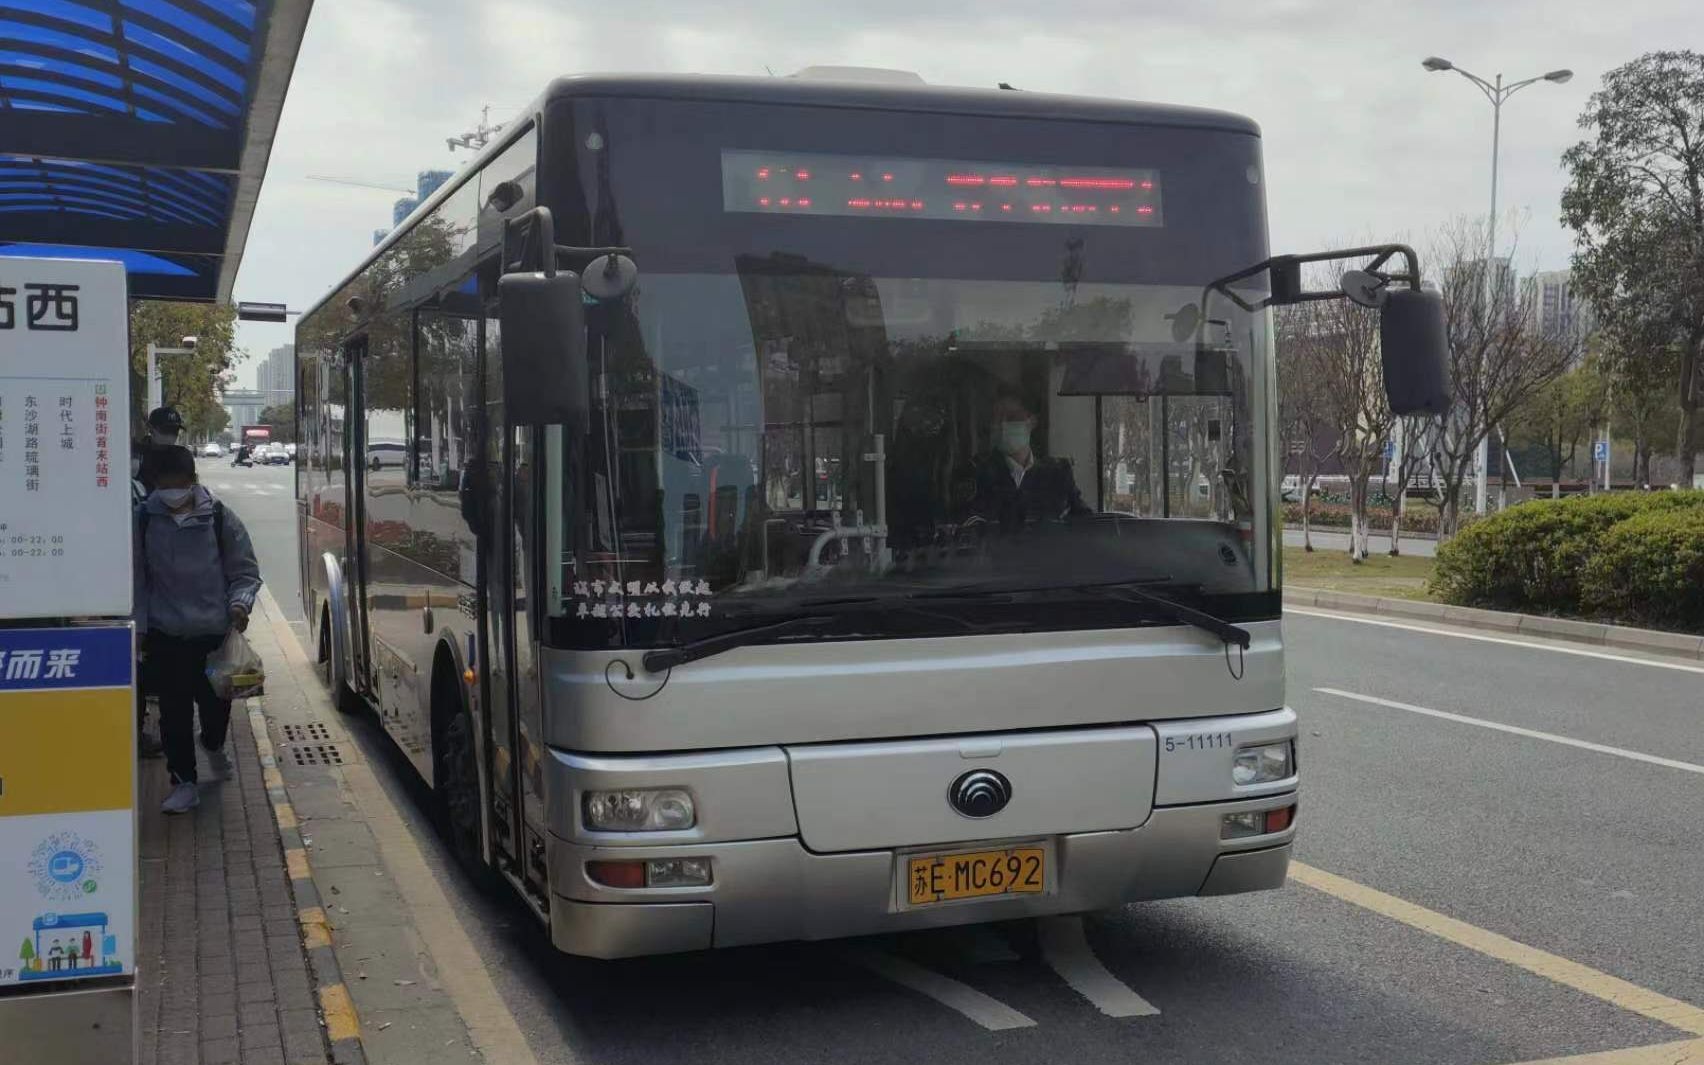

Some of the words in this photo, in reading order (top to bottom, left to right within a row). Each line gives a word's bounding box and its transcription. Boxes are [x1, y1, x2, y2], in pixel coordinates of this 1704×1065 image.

[24, 395, 39, 492] 东沙湖路琉璃街
[59, 396, 74, 450] 时代上城
[1165, 732, 1232, 752] 5-11111
